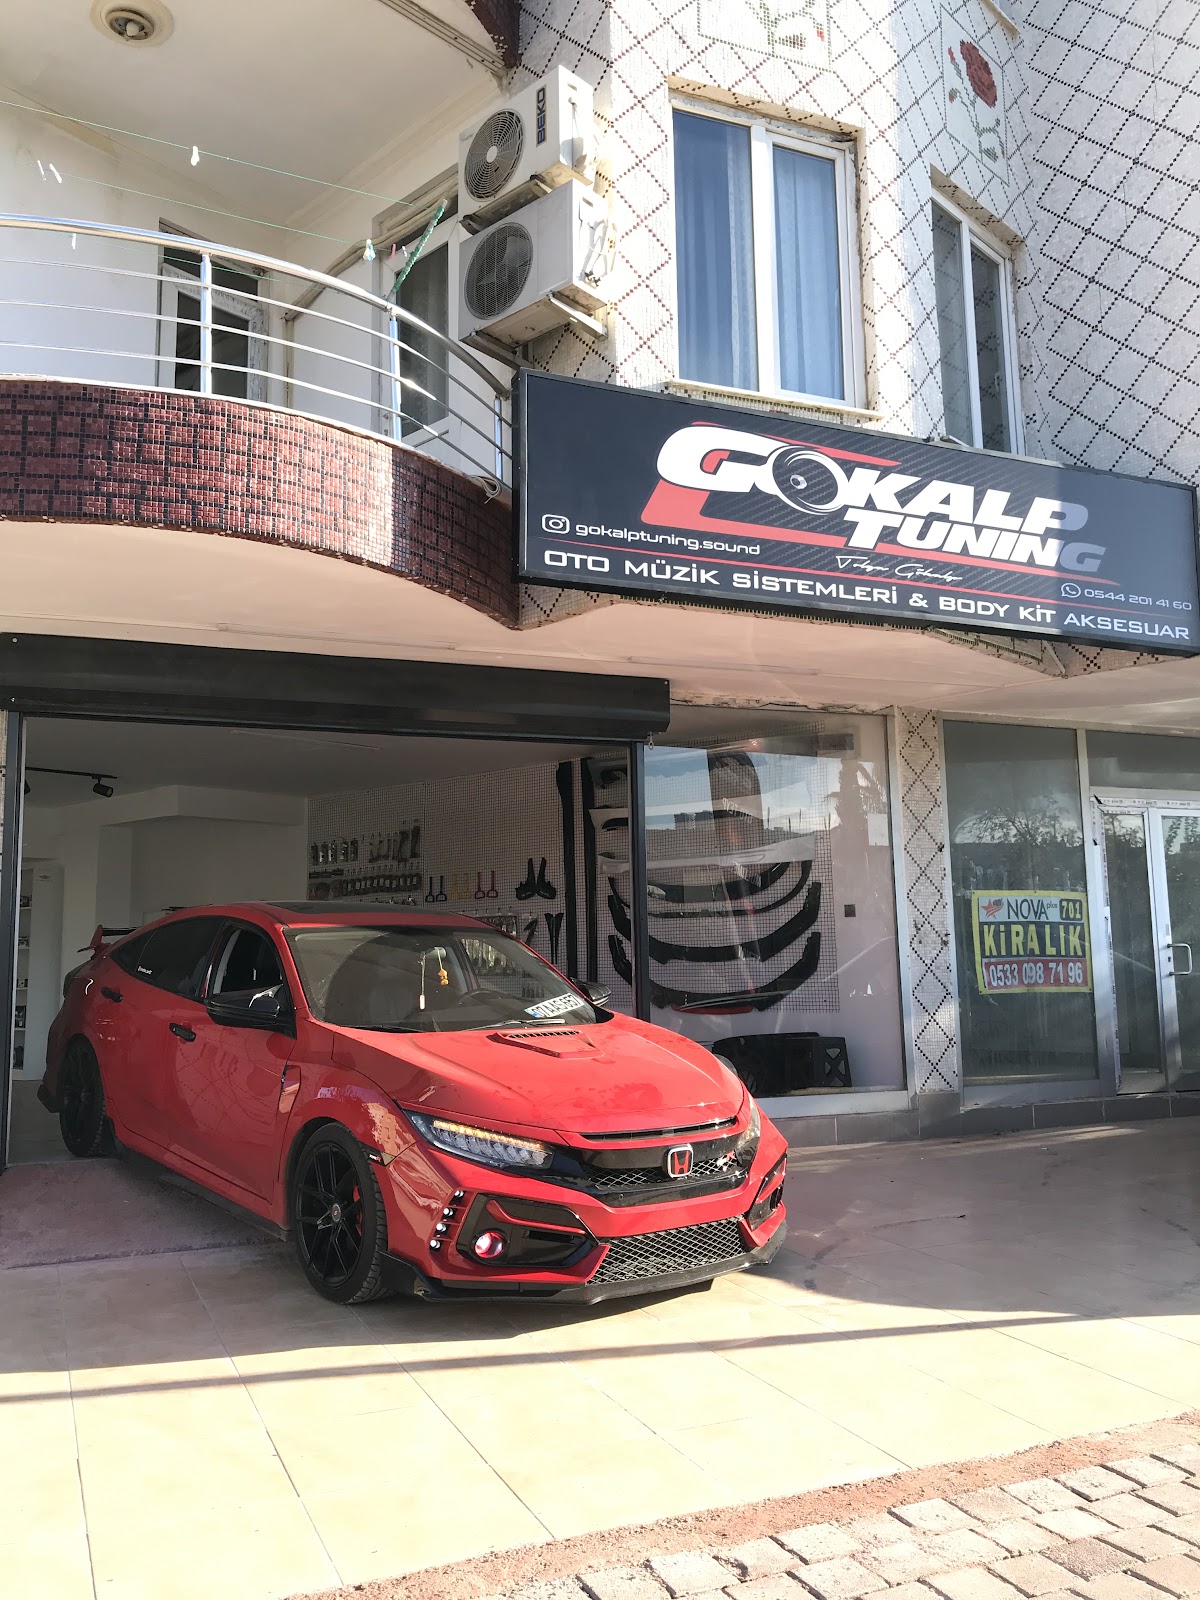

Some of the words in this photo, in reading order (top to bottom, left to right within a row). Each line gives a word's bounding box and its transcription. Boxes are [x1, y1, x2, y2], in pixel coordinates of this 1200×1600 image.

[536, 87, 546, 145] BEKO
[575, 523, 760, 555] gokalptuning.sound
[843, 507, 1107, 573] TUNING
[544, 550, 610, 573] OTO
[908, 593, 929, 608] &
[939, 596, 1011, 618] BODY
[1064, 612, 1190, 640] AKSESUAR
[1084, 588, 1126, 602] 0544
[1128, 594, 1153, 606] 201
[1155, 597, 1170, 608] 41
[1173, 600, 1192, 611] 60
[1007, 898, 1049, 920] NOVA
[1061, 900, 1082, 919] 701
[989, 963, 1019, 987] 0533
[1022, 962, 1044, 985] 098
[1048, 962, 1065, 984] 71
[1067, 961, 1083, 984] 96
